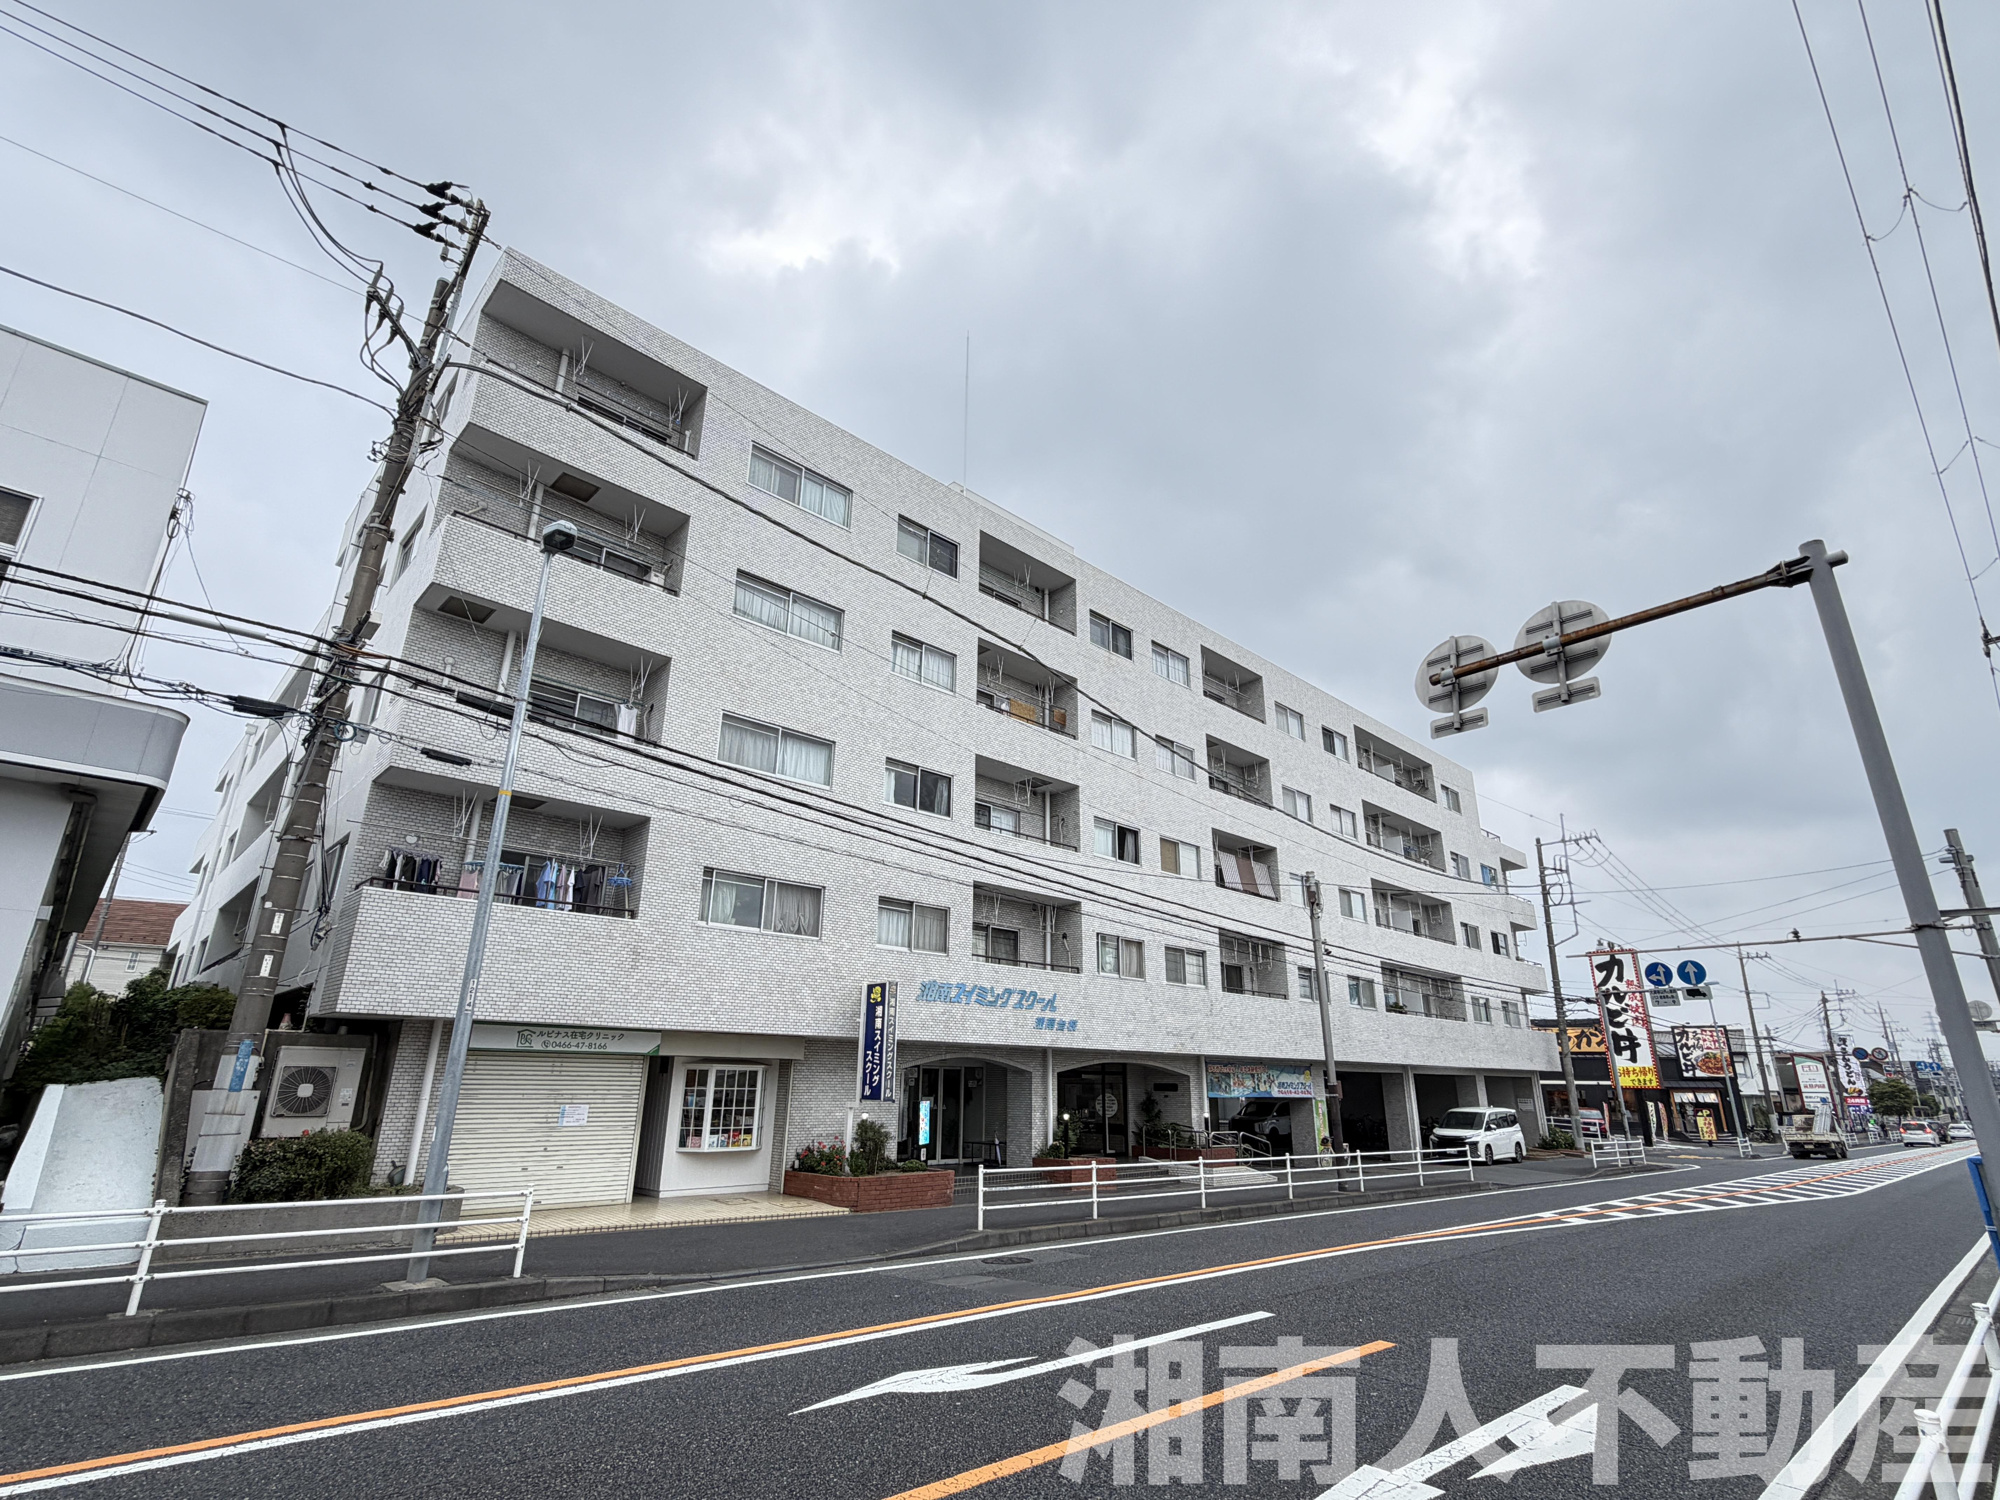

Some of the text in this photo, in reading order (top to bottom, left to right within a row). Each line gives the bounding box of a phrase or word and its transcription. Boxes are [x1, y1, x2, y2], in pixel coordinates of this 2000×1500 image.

[466, 980, 476, 1008] 1214
[917, 980, 1057, 1012] 湘南スイミングスクール
[551, 1041, 608, 1050] 0466-47-8166
[872, 1005, 883, 1087] 湘南スイミング
[863, 1051, 873, 1096] スクール
[1629, 1077, 1654, 1086] できます
